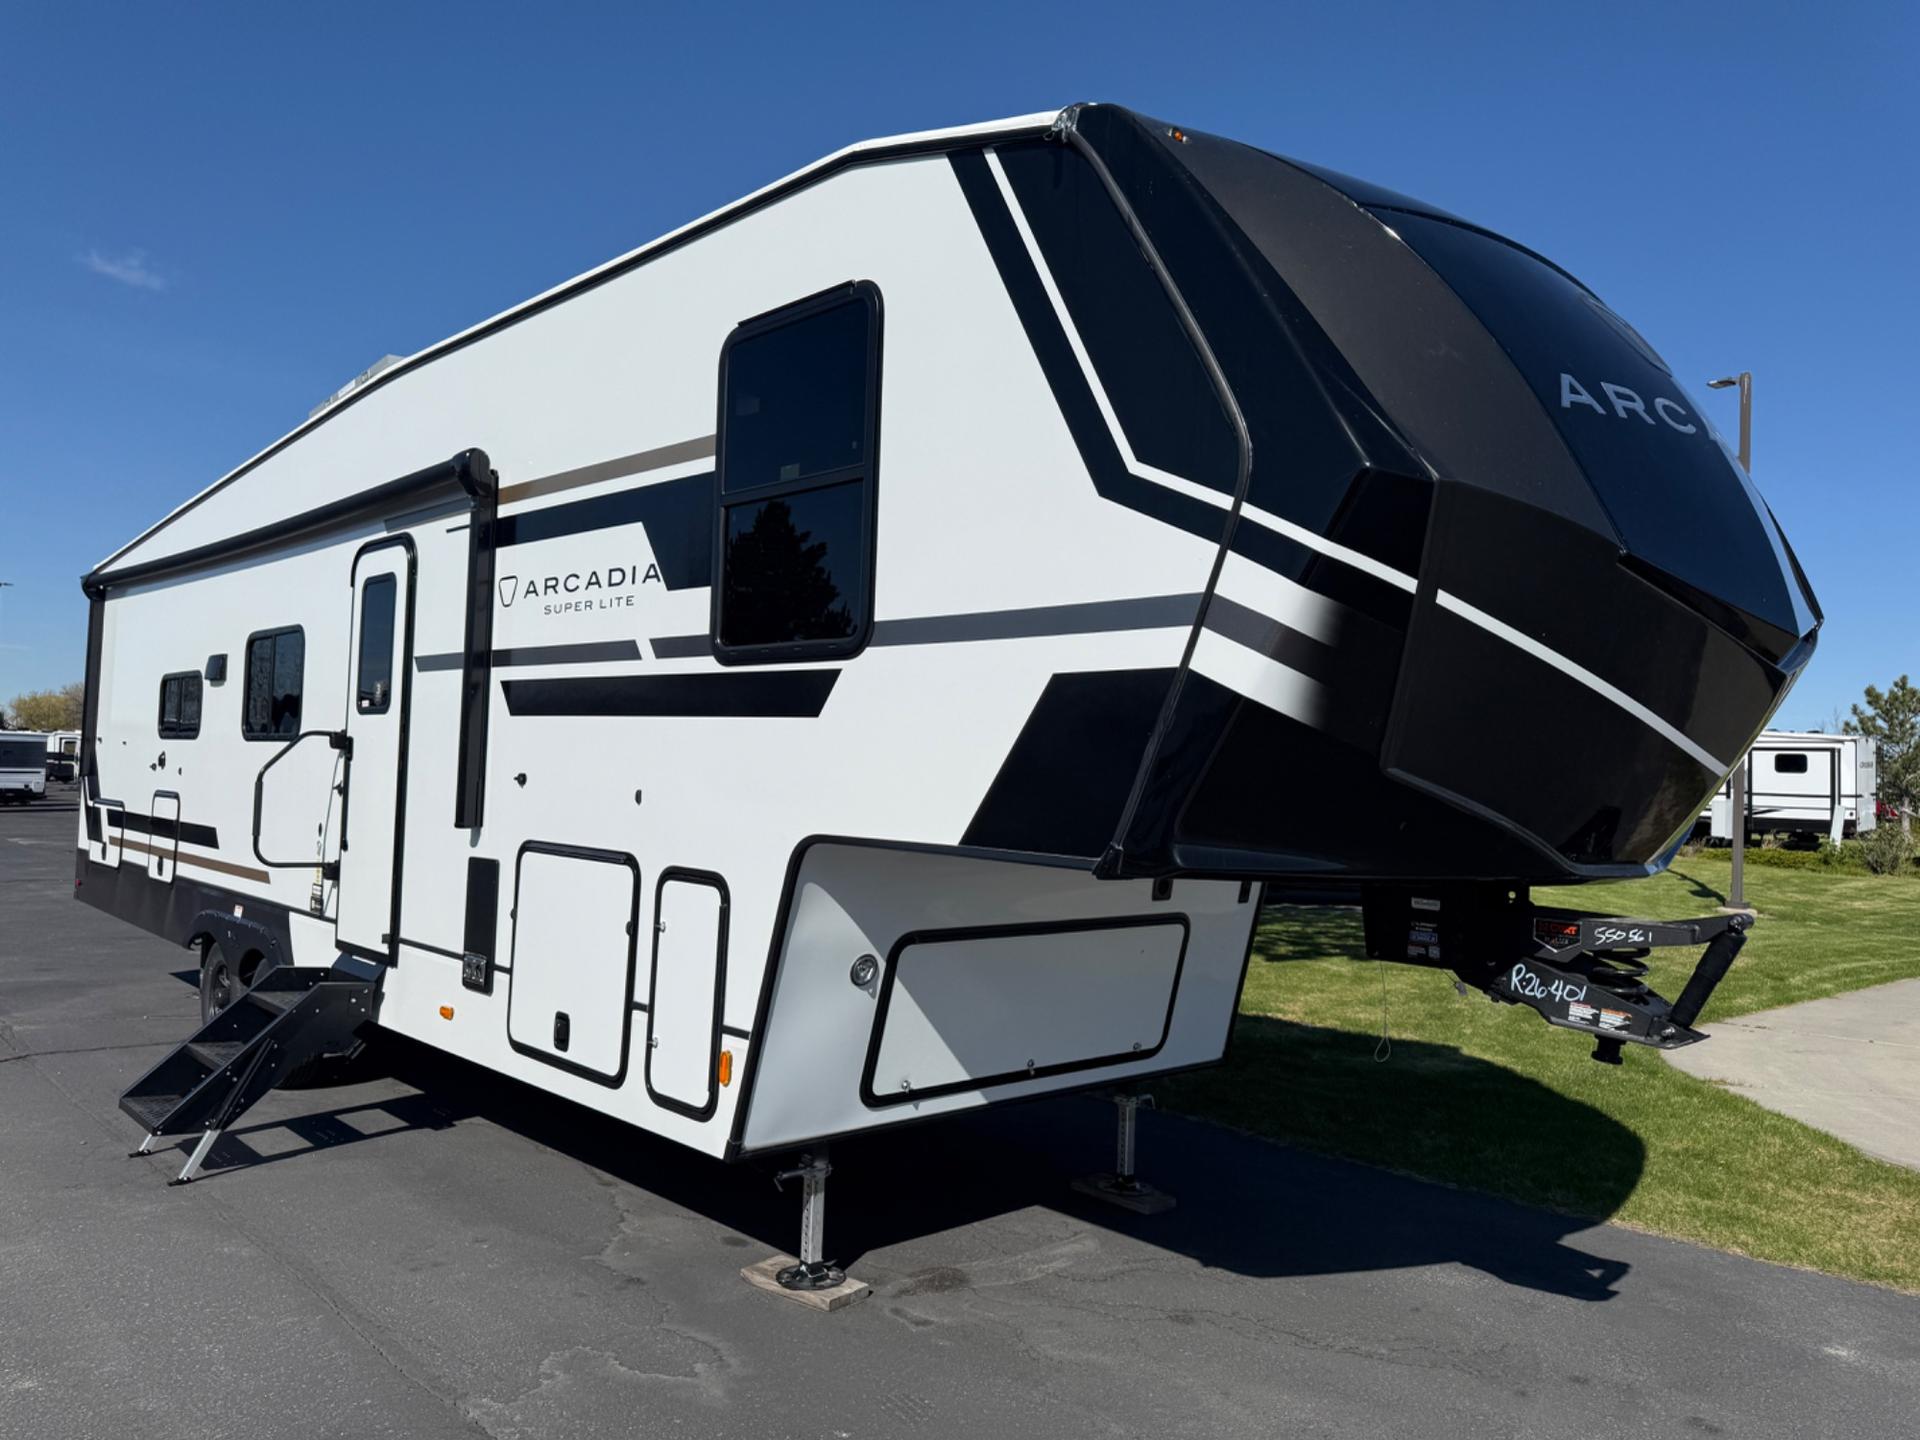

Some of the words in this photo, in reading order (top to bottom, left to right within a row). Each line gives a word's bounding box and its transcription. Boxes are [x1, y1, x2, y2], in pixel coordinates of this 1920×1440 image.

[1560, 373, 1712, 438] ARC
[523, 563, 661, 599] ARCADIA
[544, 600, 593, 616] SUPER
[599, 595, 635, 609] LITE
